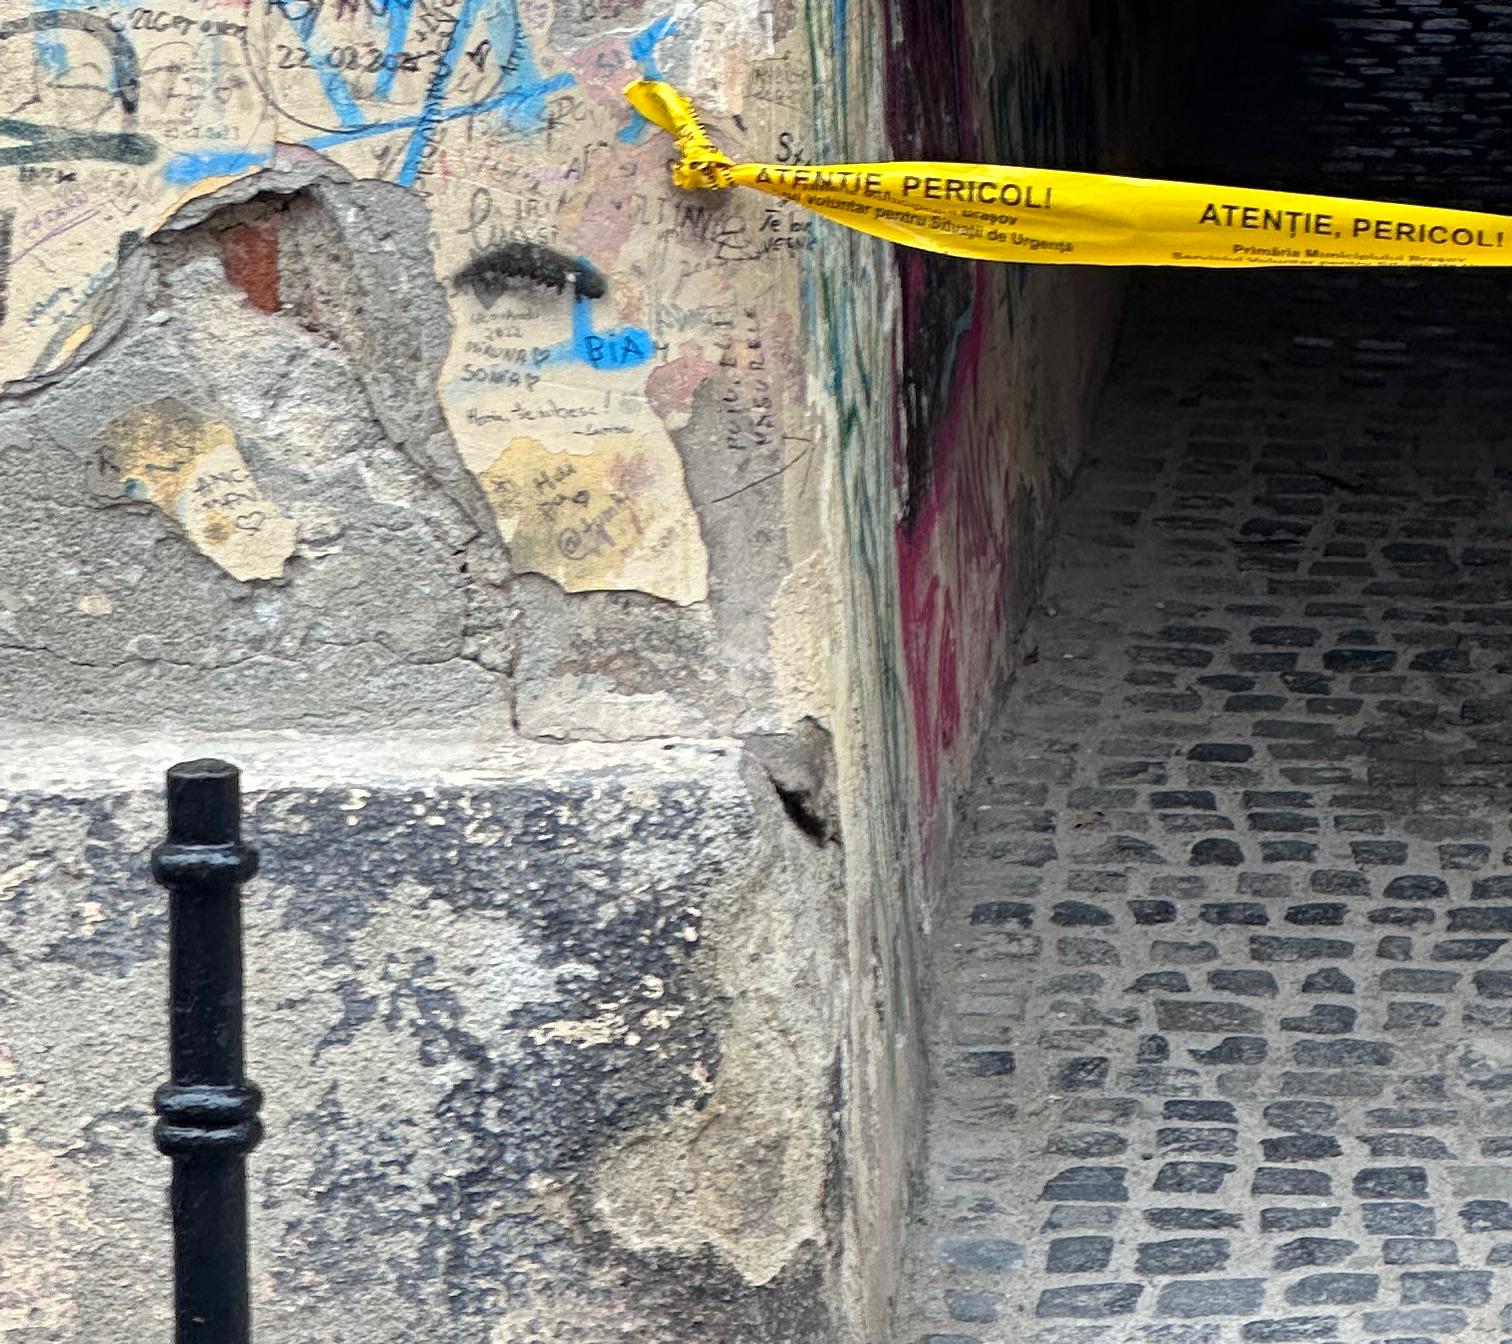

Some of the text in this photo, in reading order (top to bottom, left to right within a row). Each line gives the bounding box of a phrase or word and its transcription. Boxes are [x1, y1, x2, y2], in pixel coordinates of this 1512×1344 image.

[987, 226, 1008, 243] de
[1199, 202, 1505, 248] ATENȚIE, PERICOL!
